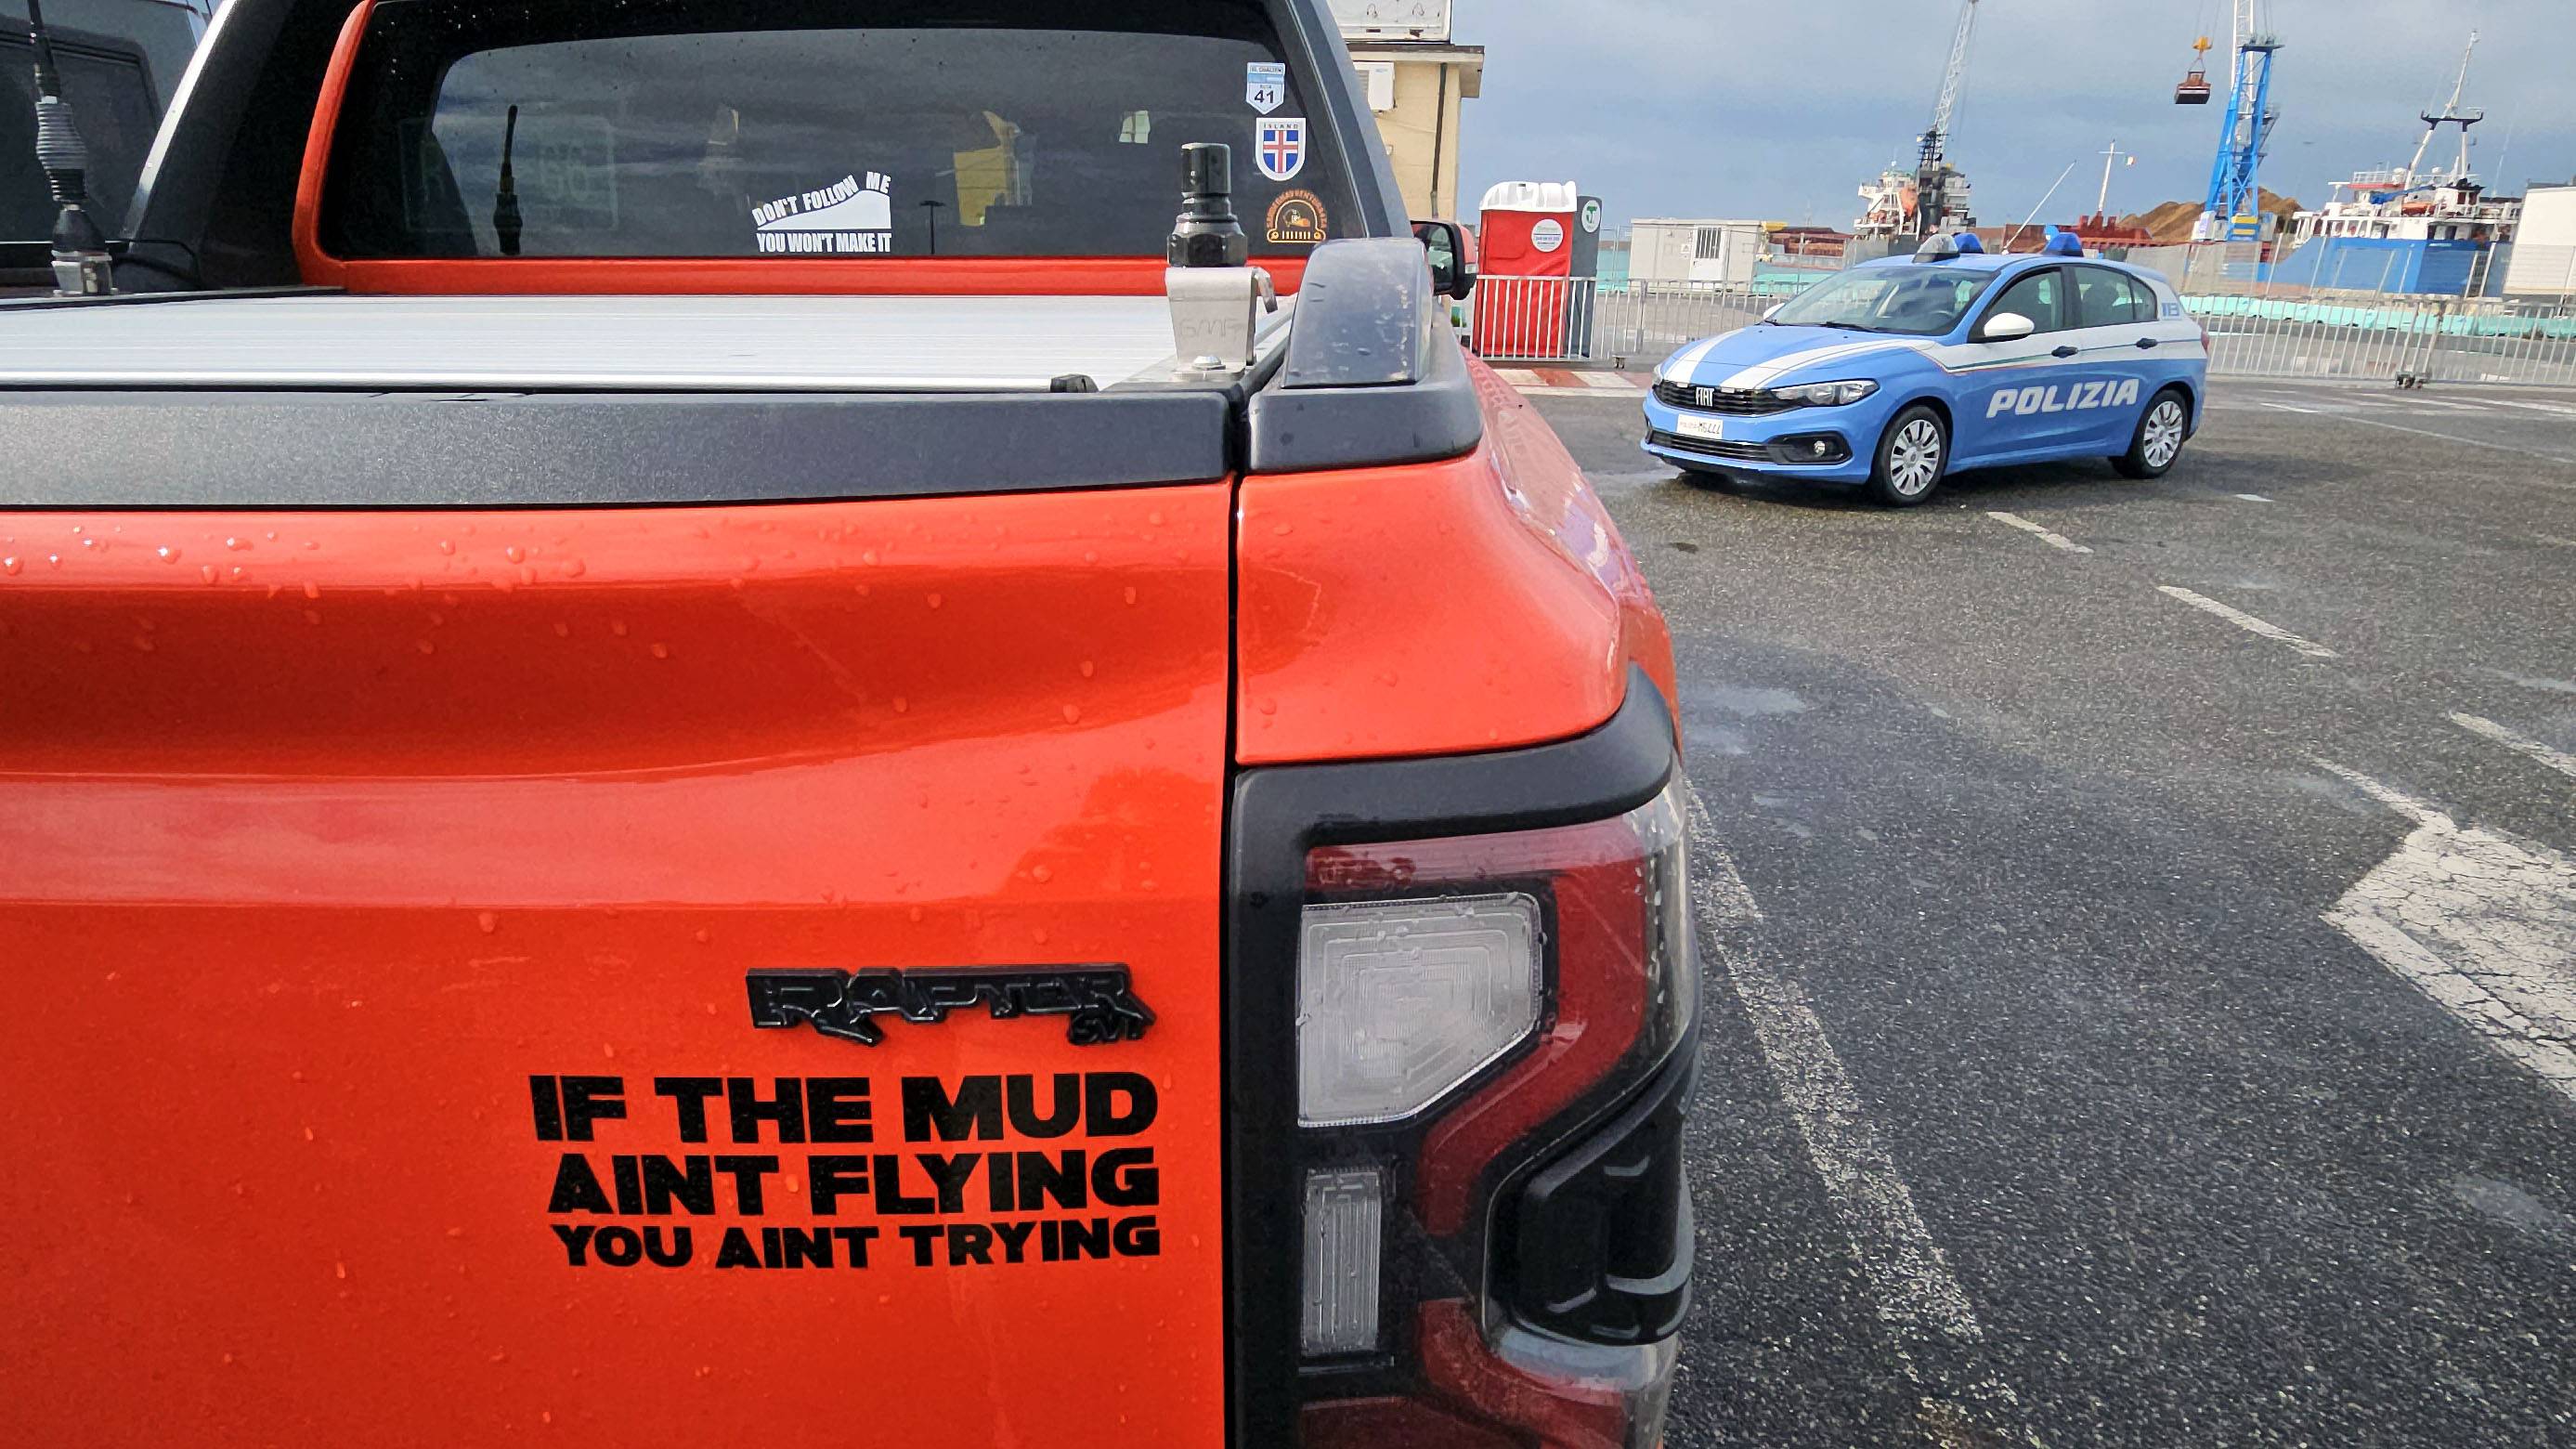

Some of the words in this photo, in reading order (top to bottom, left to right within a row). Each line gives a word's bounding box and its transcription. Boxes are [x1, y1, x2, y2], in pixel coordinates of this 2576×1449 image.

[1255, 89, 1274, 104] 41
[752, 196, 798, 226] DON'T
[802, 175, 859, 211] FOLLOW
[865, 171, 891, 194] ME
[756, 233, 787, 253] YOU
[787, 233, 834, 253] WON'T
[836, 233, 877, 253] MAKE
[877, 233, 892, 253] IT
[1696, 386, 1714, 407] FIAT
[1985, 378, 2140, 419] POLIZIA
[746, 963, 1157, 1047] RAPTOR
[530, 1076, 627, 1142] IF
[654, 1077, 874, 1143] THE
[902, 1072, 1158, 1142] MUD
[548, 1153, 780, 1216] AINT
[807, 1146, 1160, 1216] FLYING
[552, 1223, 694, 1267] YOU
[715, 1225, 879, 1270] AINT
[899, 1215, 1161, 1267] TRYING
